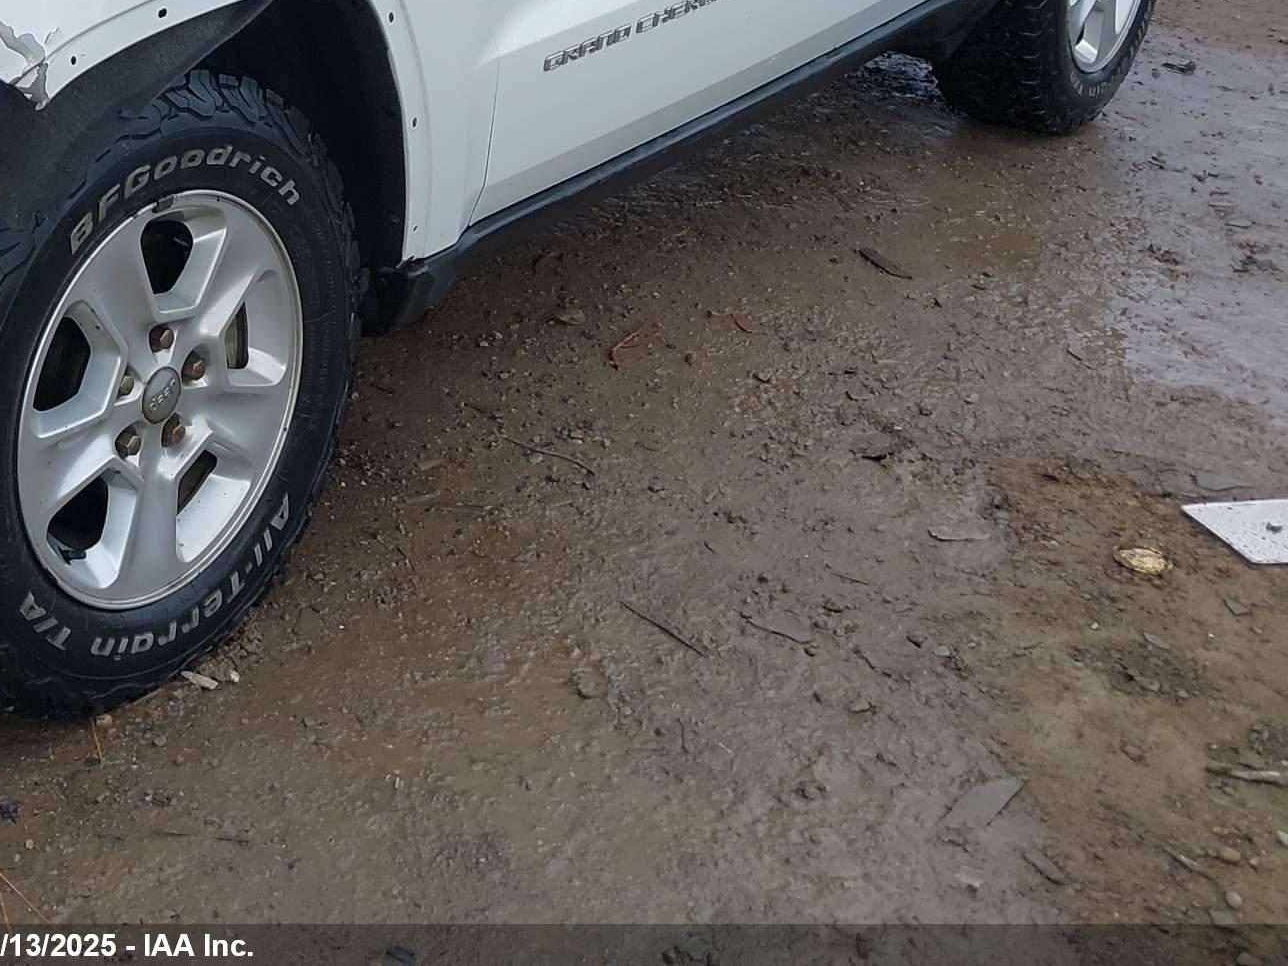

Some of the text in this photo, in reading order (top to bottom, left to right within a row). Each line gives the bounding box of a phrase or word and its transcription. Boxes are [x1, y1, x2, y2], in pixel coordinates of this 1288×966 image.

[543, 23, 632, 72] GRAND
[70, 145, 301, 256] BFGoodrich
[90, 491, 290, 662] All-Terrain
